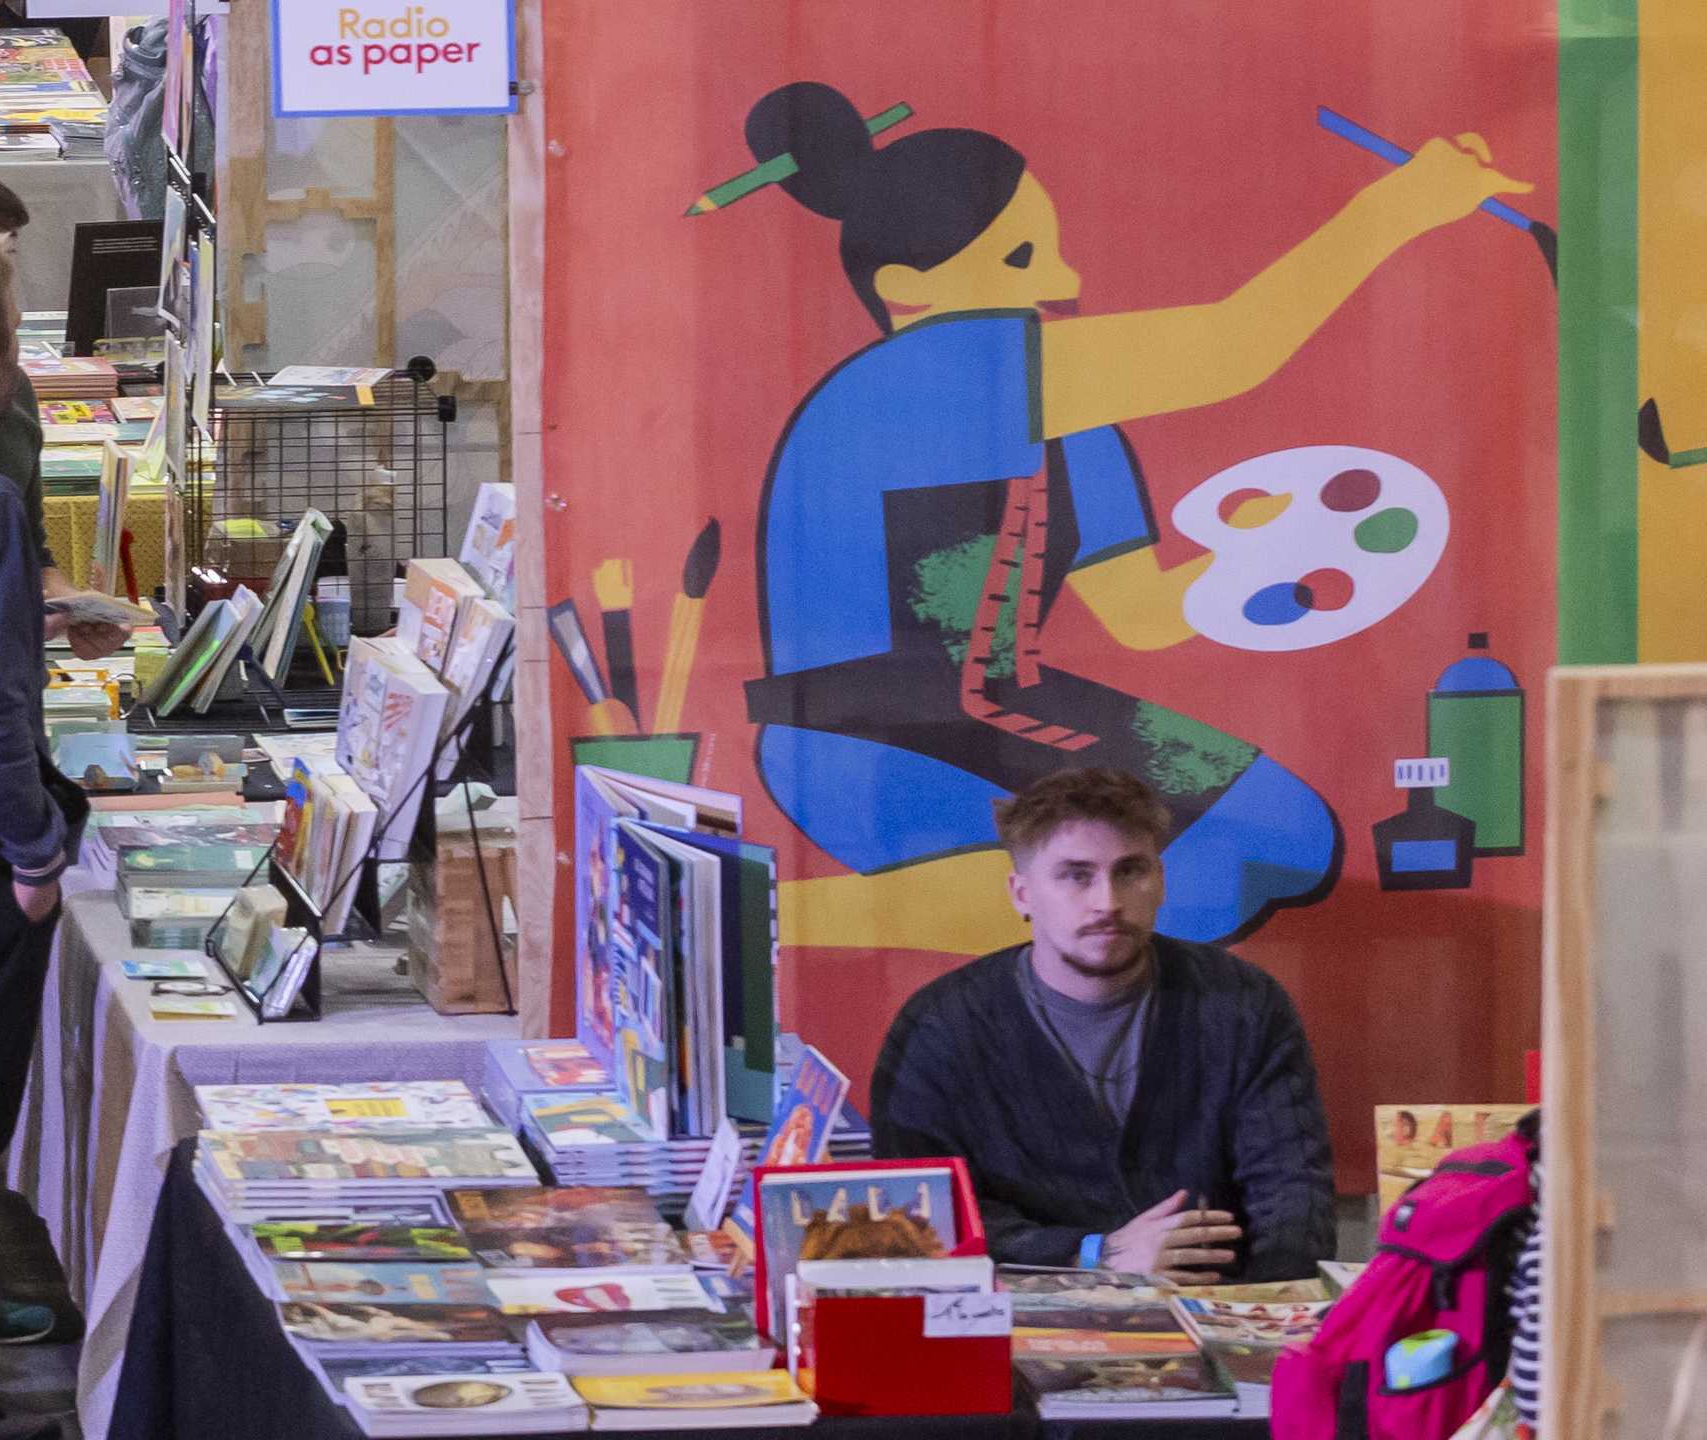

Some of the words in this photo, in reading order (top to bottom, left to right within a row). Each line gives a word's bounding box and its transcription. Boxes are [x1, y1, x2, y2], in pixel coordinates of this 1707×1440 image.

[338, 5, 451, 40] Radio
[308, 40, 352, 67] as
[362, 39, 480, 75] paper
